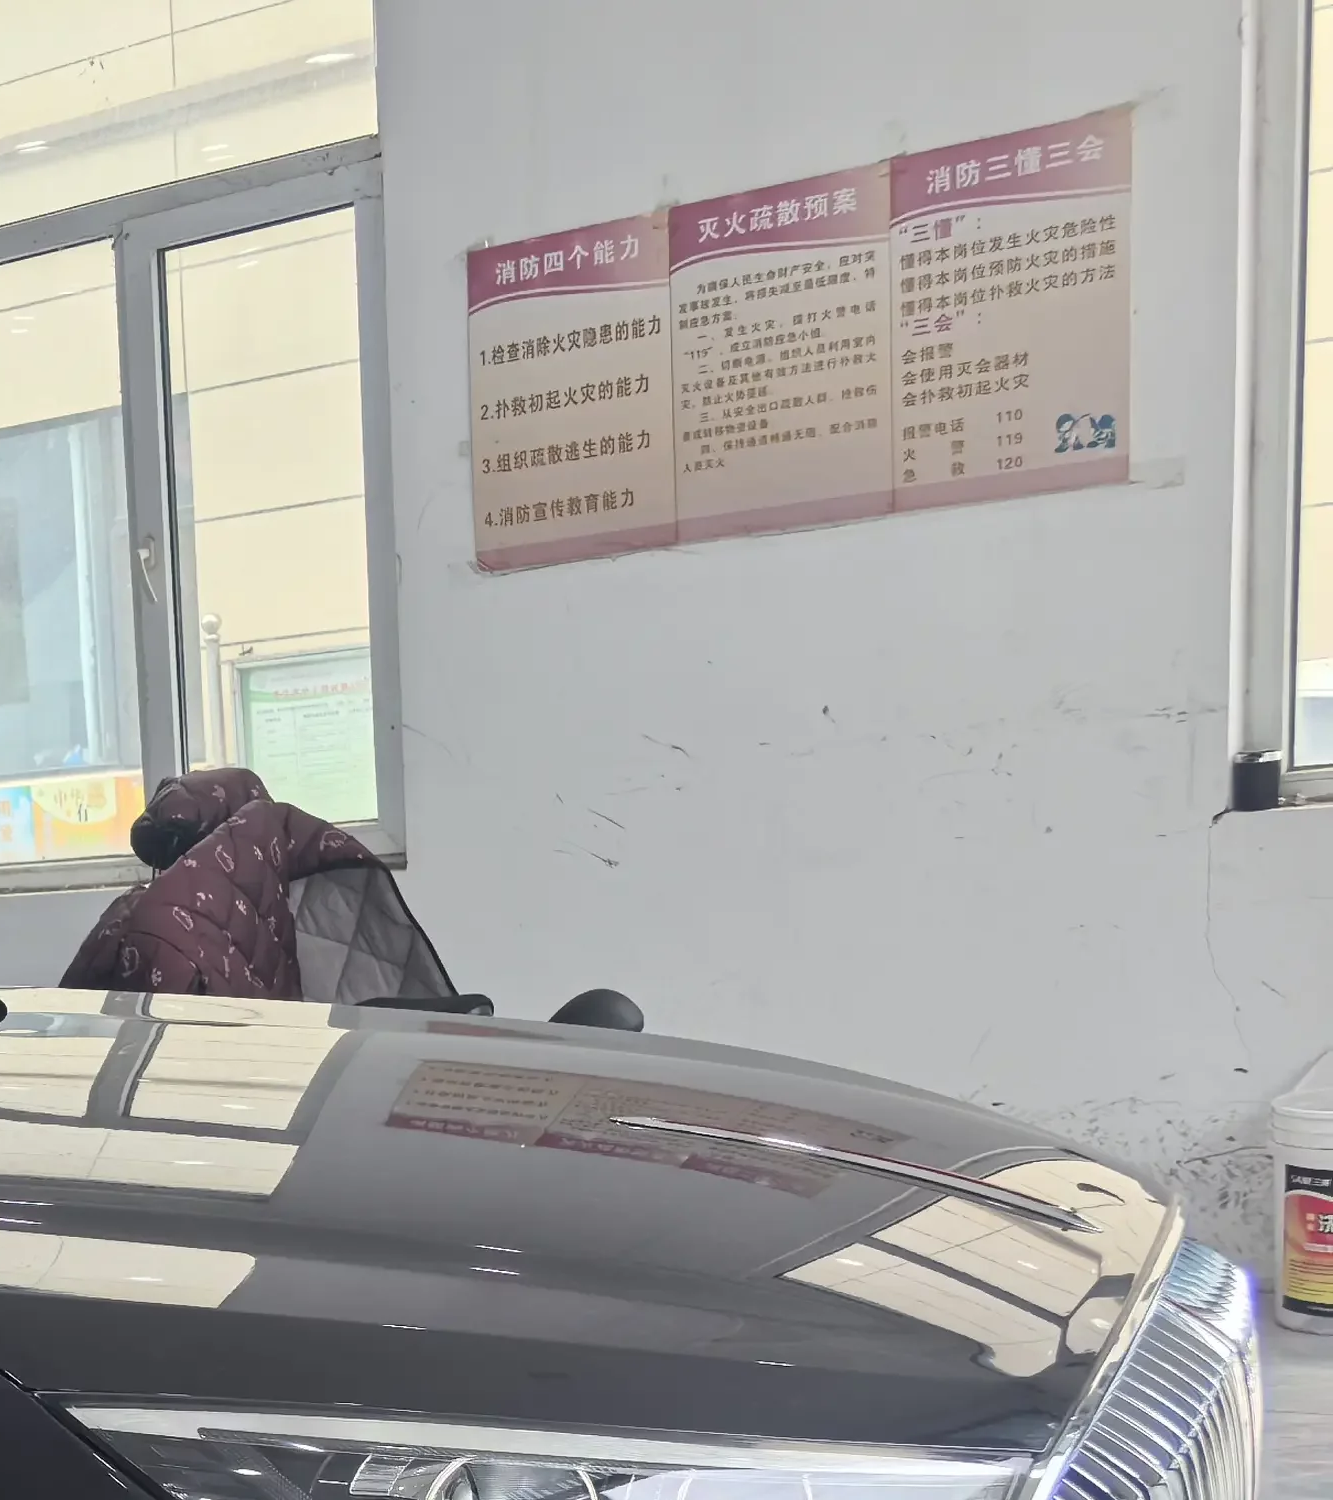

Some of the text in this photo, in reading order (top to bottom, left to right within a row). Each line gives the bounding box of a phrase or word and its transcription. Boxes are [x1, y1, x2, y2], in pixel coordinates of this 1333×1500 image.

[926, 134, 1105, 195] 消防三懂三会
[698, 188, 858, 243] 灭火疏散预案
[495, 234, 640, 286] 消防四个能力
[899, 213, 1117, 271] 懂得本岗位发生火灾危险性
[900, 239, 1117, 295] 懂得本岗位预防火灾的措施
[900, 263, 1116, 318] 懂得本岗位扑救火灾的方法
[479, 314, 662, 367] 1.检查消除火灾隐患的能力
[901, 342, 954, 365] 会报警
[480, 373, 650, 421] 2.扑救初起火灾的能力
[902, 373, 1030, 408] 会扑救初起火灾
[903, 408, 1024, 441] 报警电话 110
[903, 448, 917, 463] 火
[997, 432, 1024, 448] 119
[482, 429, 651, 475] 3.组织疏散逃生的能力
[997, 456, 1024, 471] 120
[484, 488, 635, 528] 4.消防宣传教育能力
